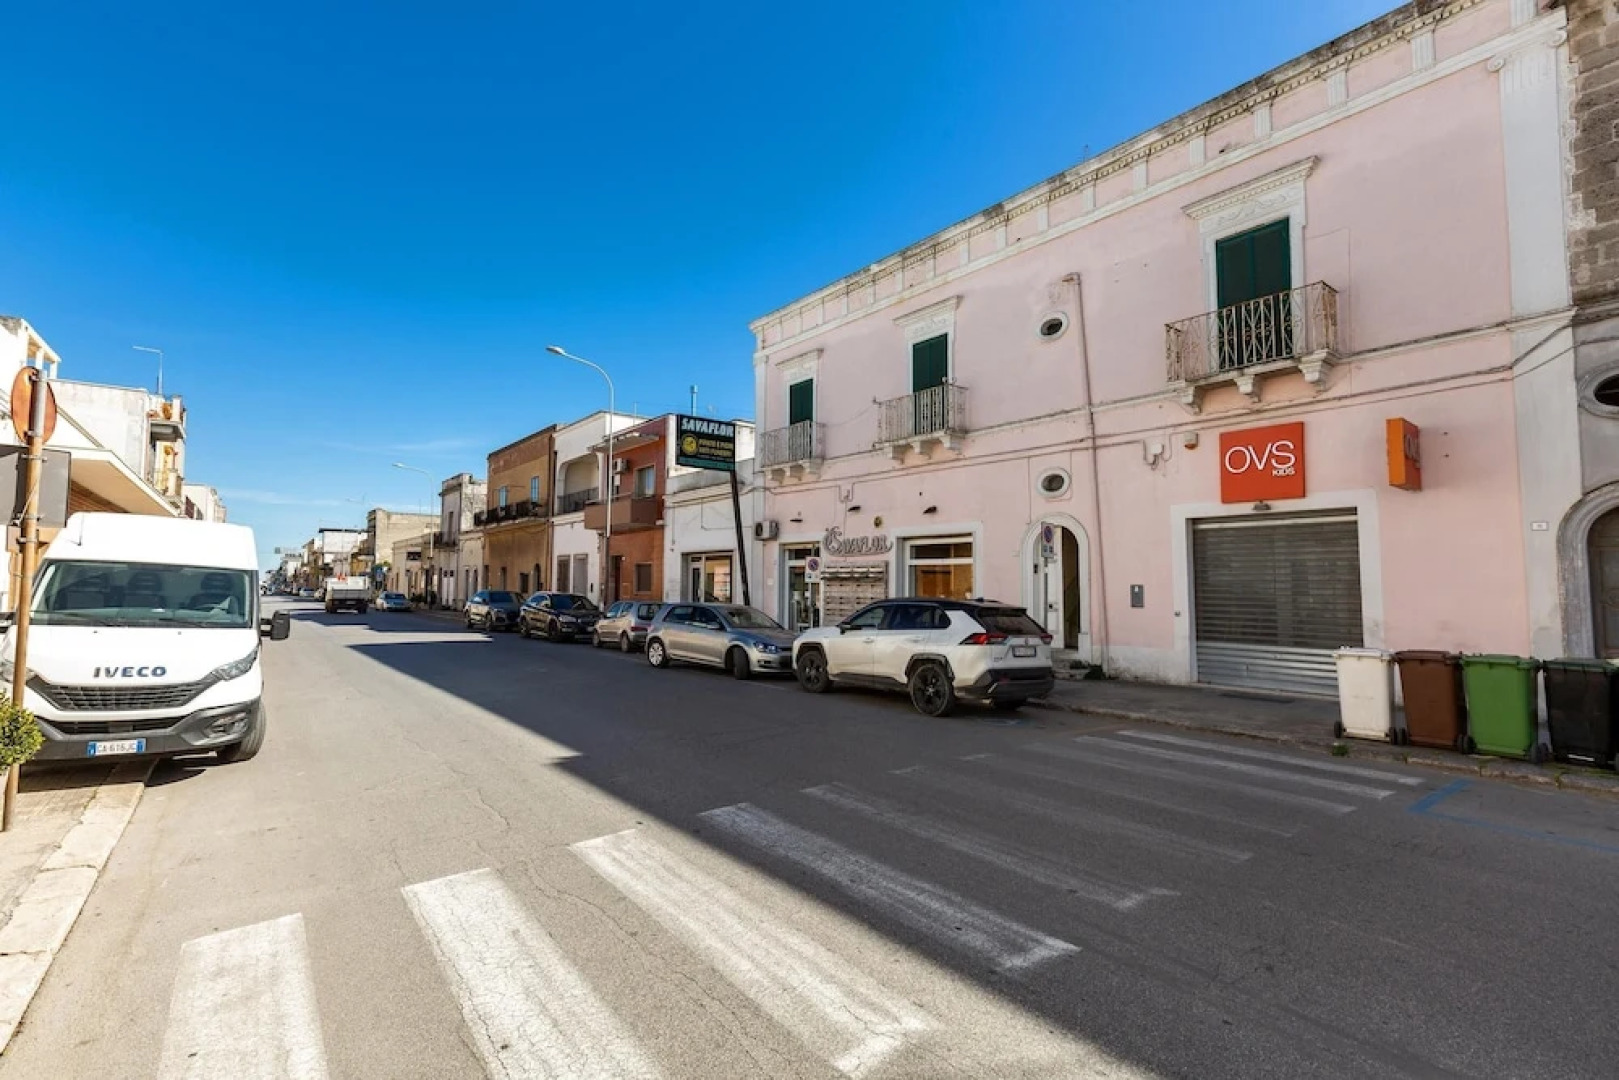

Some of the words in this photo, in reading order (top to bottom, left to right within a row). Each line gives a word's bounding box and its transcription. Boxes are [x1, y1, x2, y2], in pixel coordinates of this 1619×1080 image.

[1225, 440, 1296, 474] OVS
[1272, 467, 1296, 477] KIDS
[93, 666, 167, 678] IVECO
